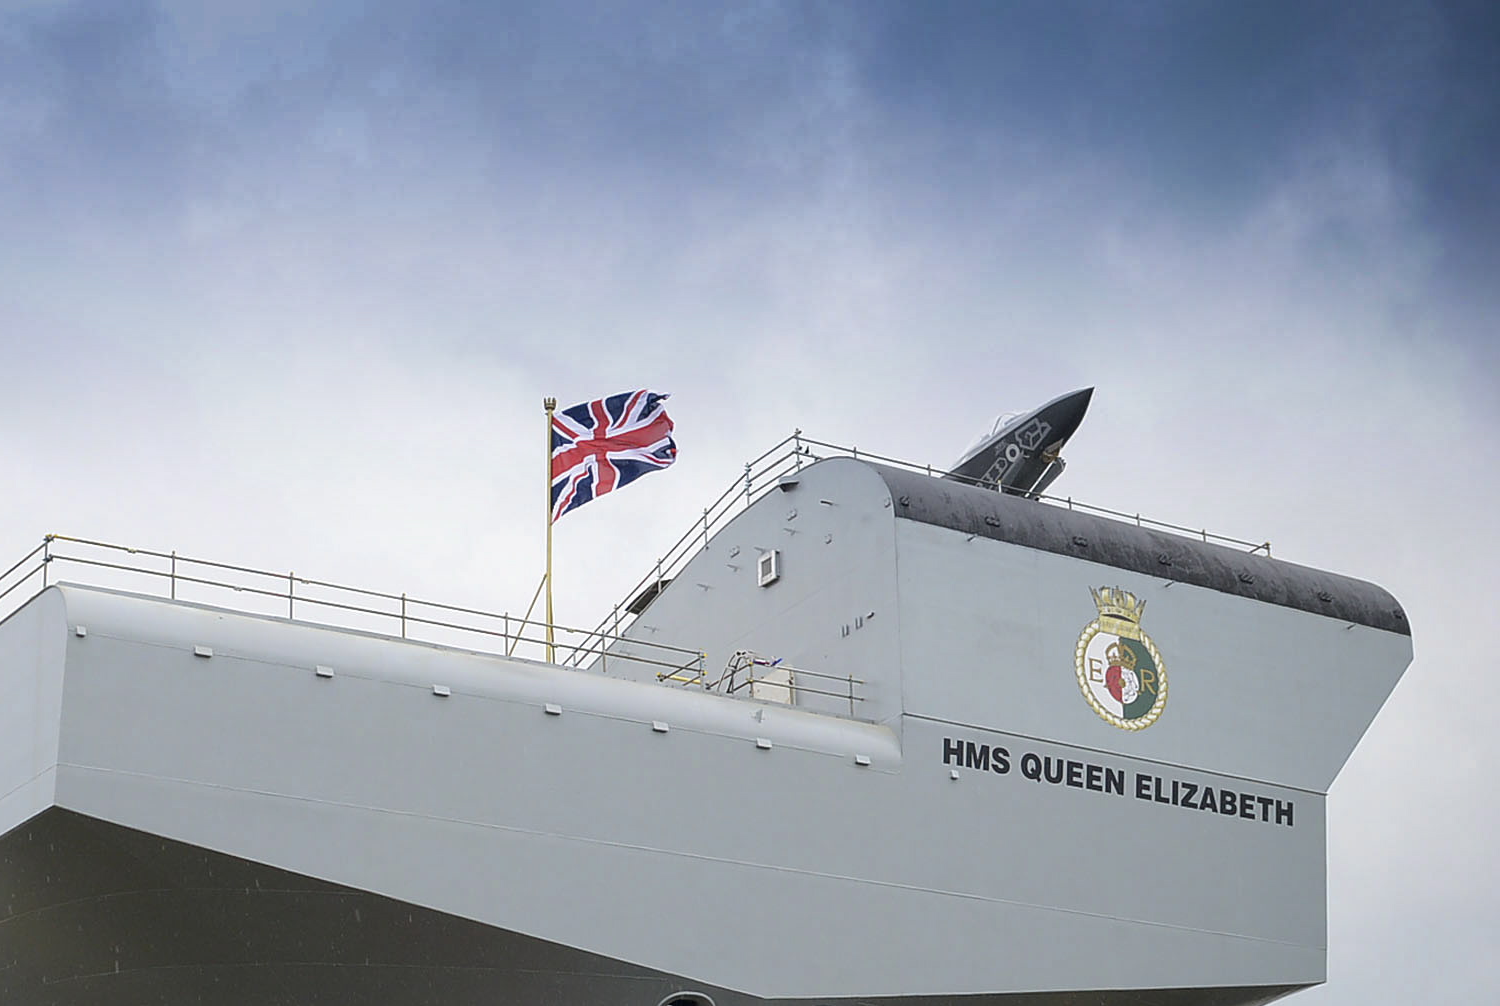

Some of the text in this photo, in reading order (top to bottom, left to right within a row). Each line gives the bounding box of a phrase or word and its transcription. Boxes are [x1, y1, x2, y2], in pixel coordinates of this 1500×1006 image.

[943, 737, 1294, 827] HMS QUEEN ELIZABETH
